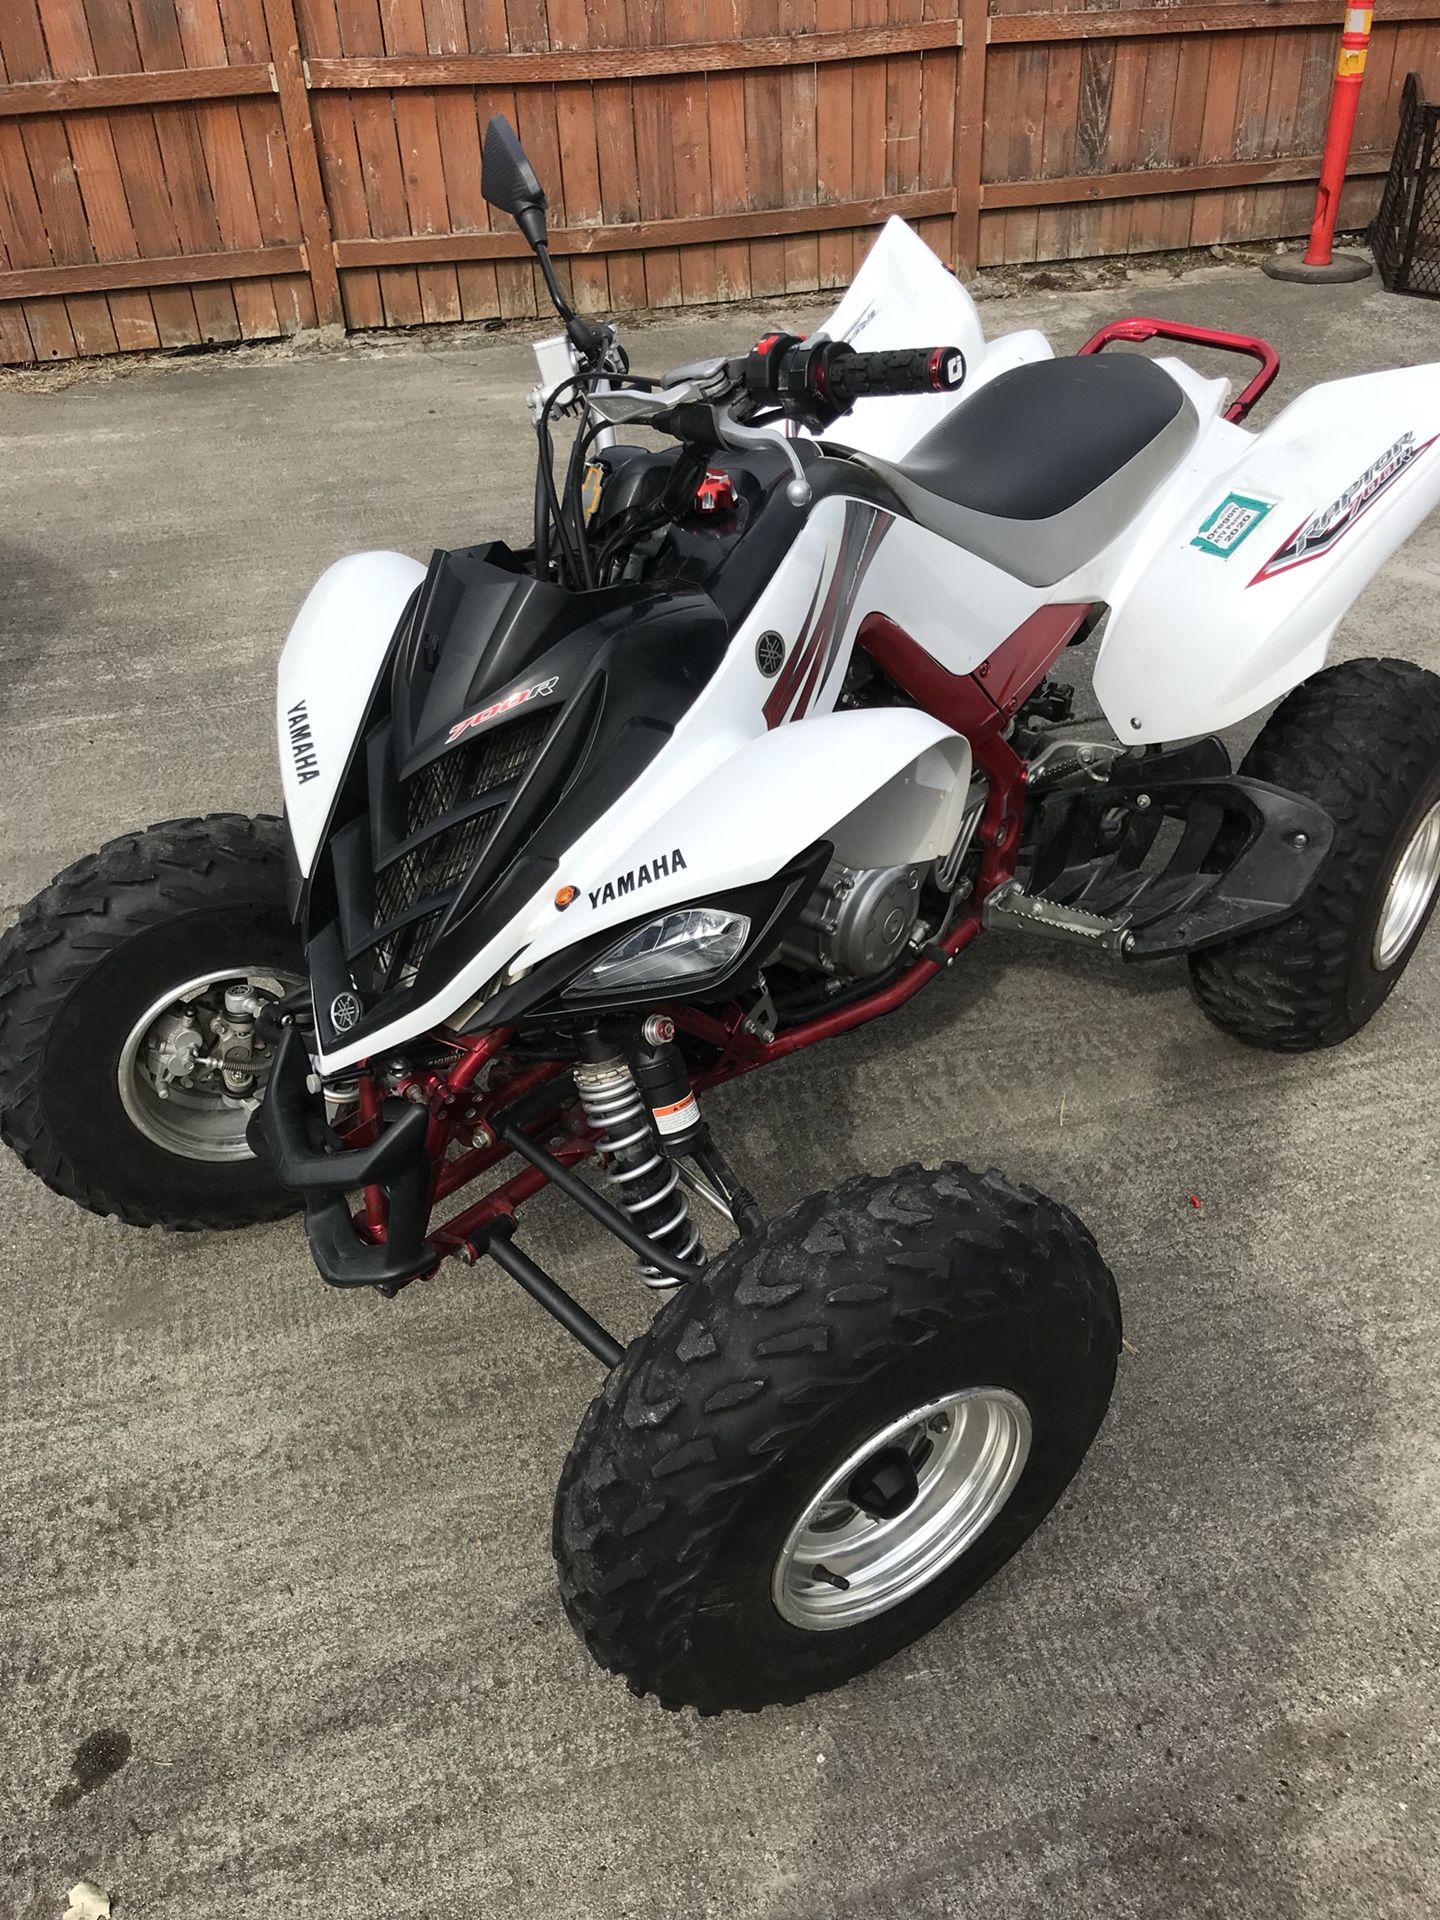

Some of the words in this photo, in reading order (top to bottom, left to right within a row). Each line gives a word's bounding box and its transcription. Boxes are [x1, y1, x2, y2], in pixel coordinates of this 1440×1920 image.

[1348, 446, 1414, 520] 700R
[1206, 507, 1239, 540] Oregon
[1213, 530, 1227, 543] ATV
[1223, 514, 1251, 542] 2020
[445, 676, 559, 745] 700R
[287, 699, 320, 785] YAMAHA
[588, 848, 688, 910] YAMAHA
